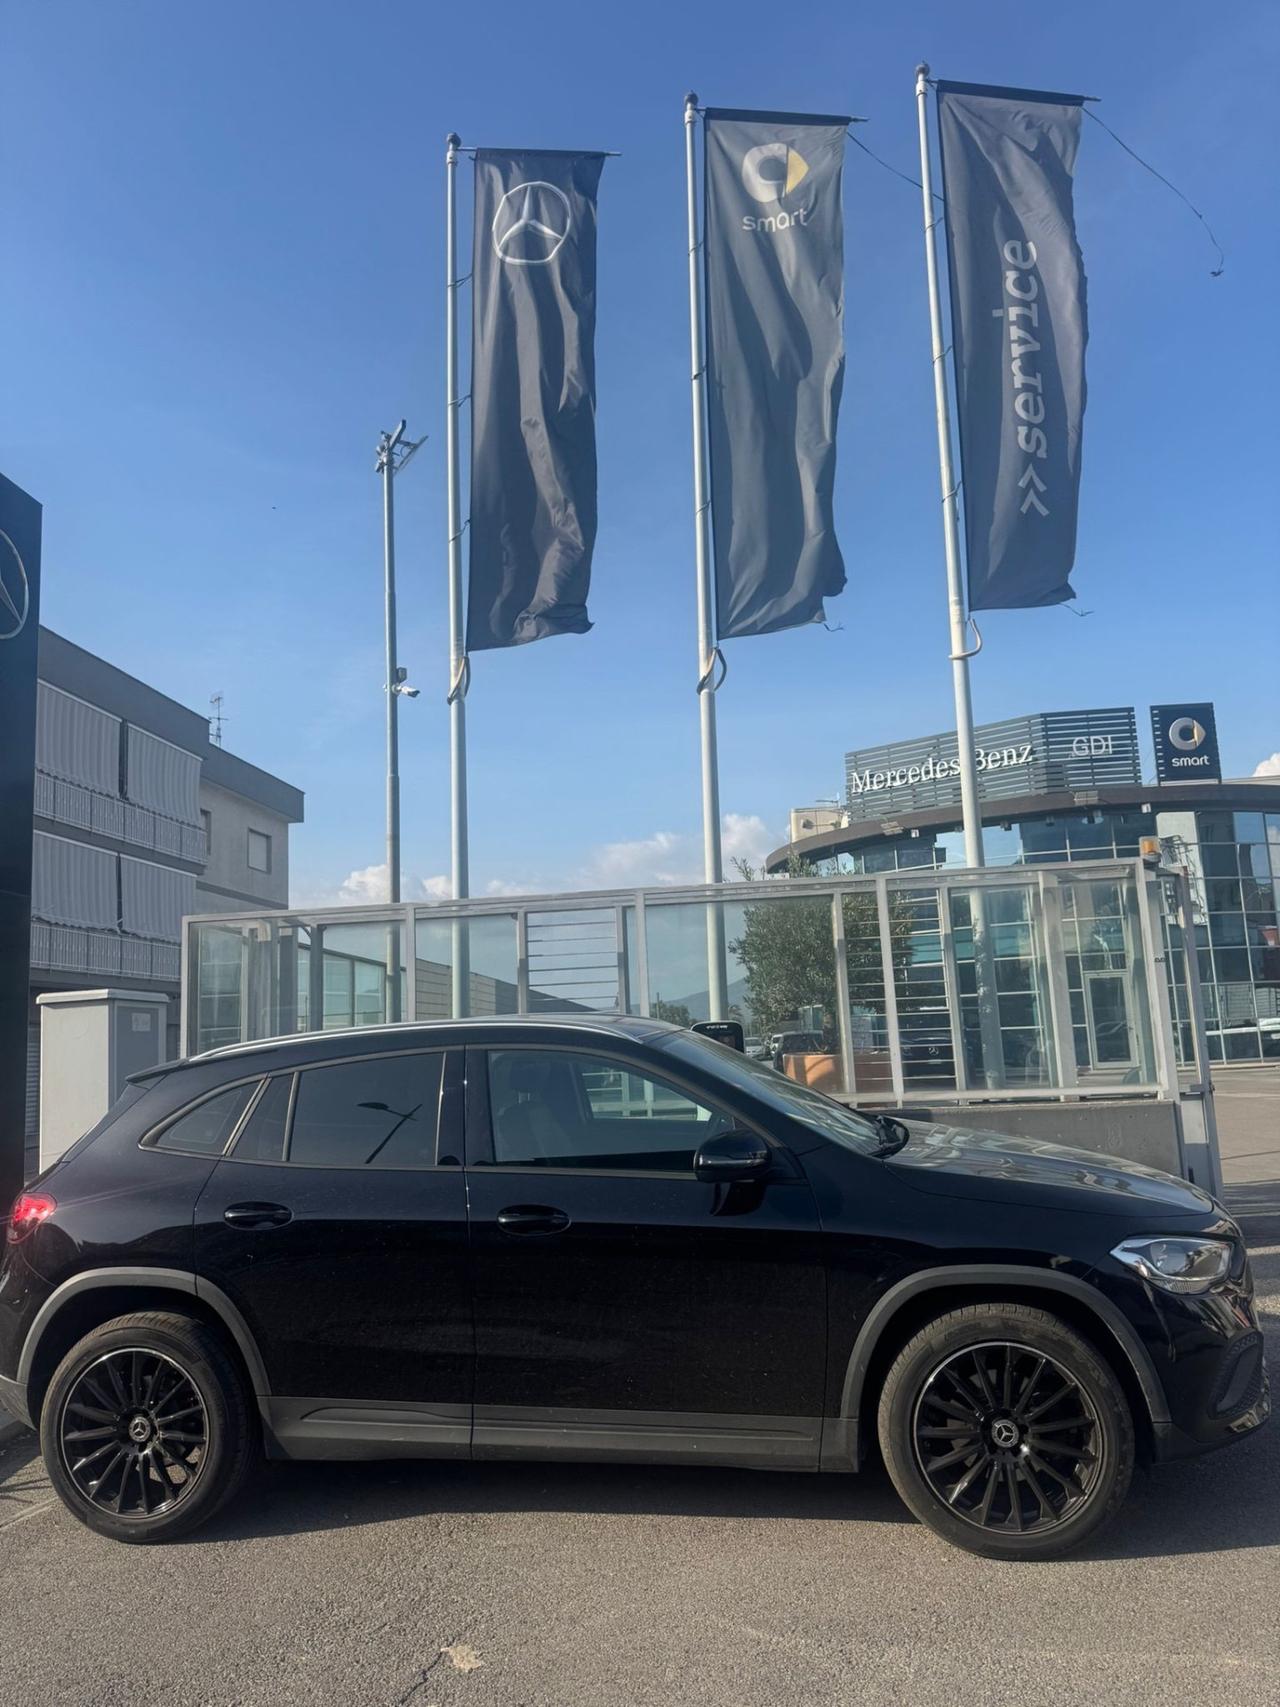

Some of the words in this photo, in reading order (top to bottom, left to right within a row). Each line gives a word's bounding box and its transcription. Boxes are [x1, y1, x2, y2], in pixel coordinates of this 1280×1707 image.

[742, 208, 807, 232] smart
[1072, 735, 1113, 757] GDI
[851, 745, 1033, 793] MercedesBenz
[1171, 755, 1210, 767] smart
